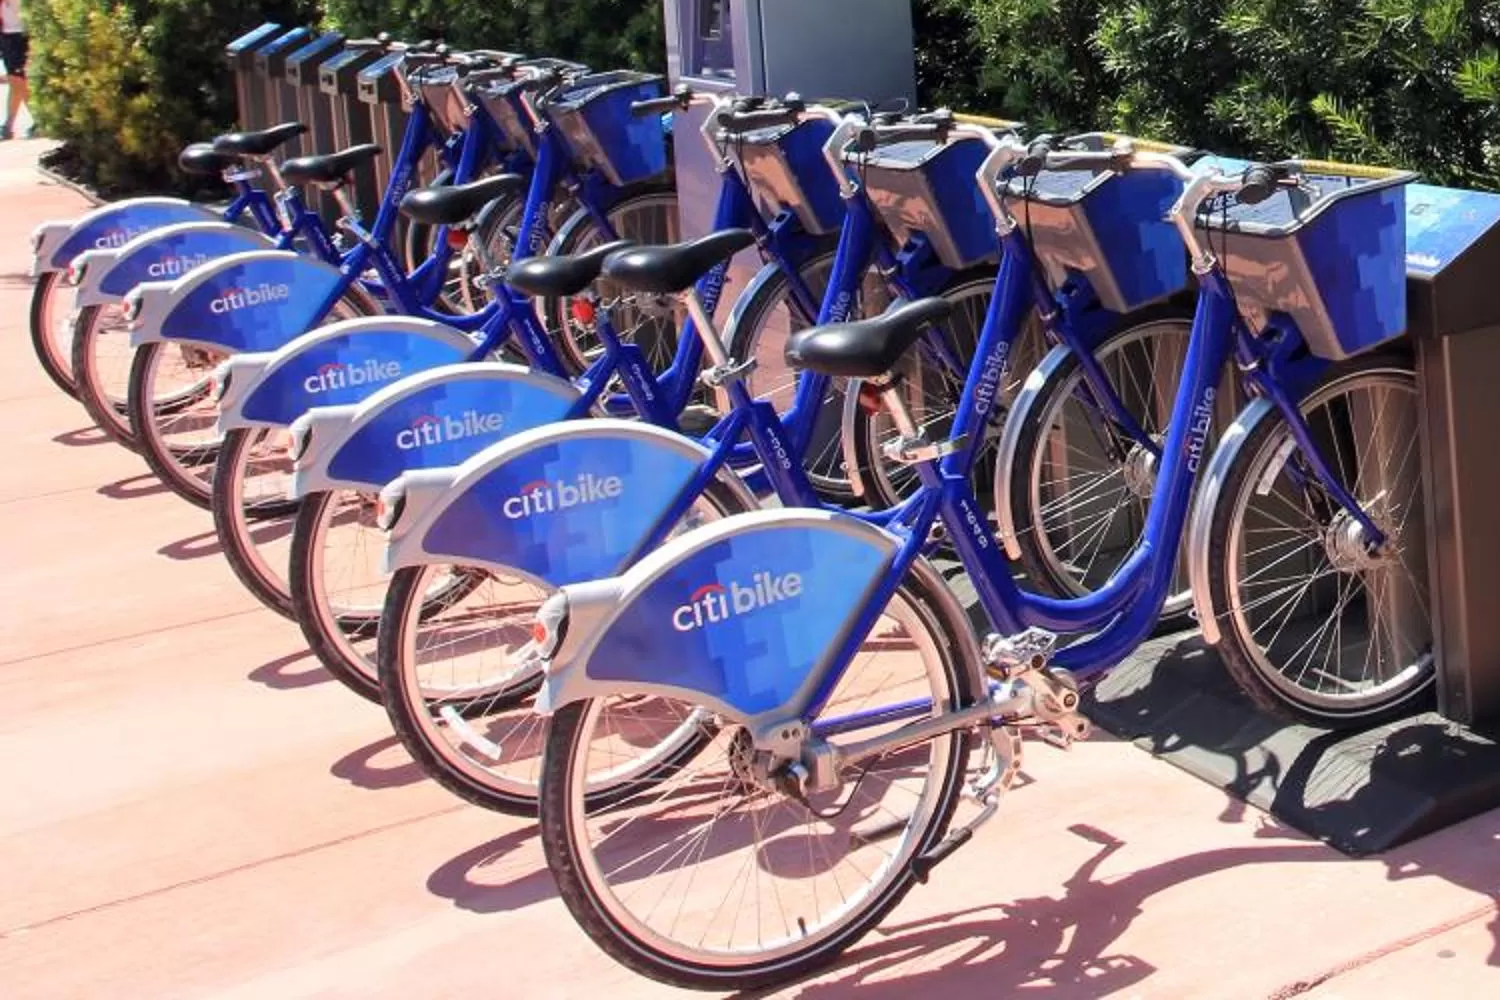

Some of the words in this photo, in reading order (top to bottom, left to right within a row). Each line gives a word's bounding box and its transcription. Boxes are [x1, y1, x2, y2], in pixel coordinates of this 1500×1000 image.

[148, 255, 180, 276] citi
[210, 286, 243, 314] citi
[246, 283, 289, 305] bike
[304, 363, 345, 393] citi
[349, 359, 400, 385] bike
[973, 380, 993, 415] citi
[983, 341, 1009, 380] bike
[396, 415, 442, 449] citi
[445, 410, 504, 440] bike
[1183, 430, 1202, 473] citi
[1194, 386, 1217, 431] bike
[503, 480, 553, 519] citi
[556, 472, 624, 508] bike
[672, 583, 729, 632] citi
[732, 571, 804, 615] bike
